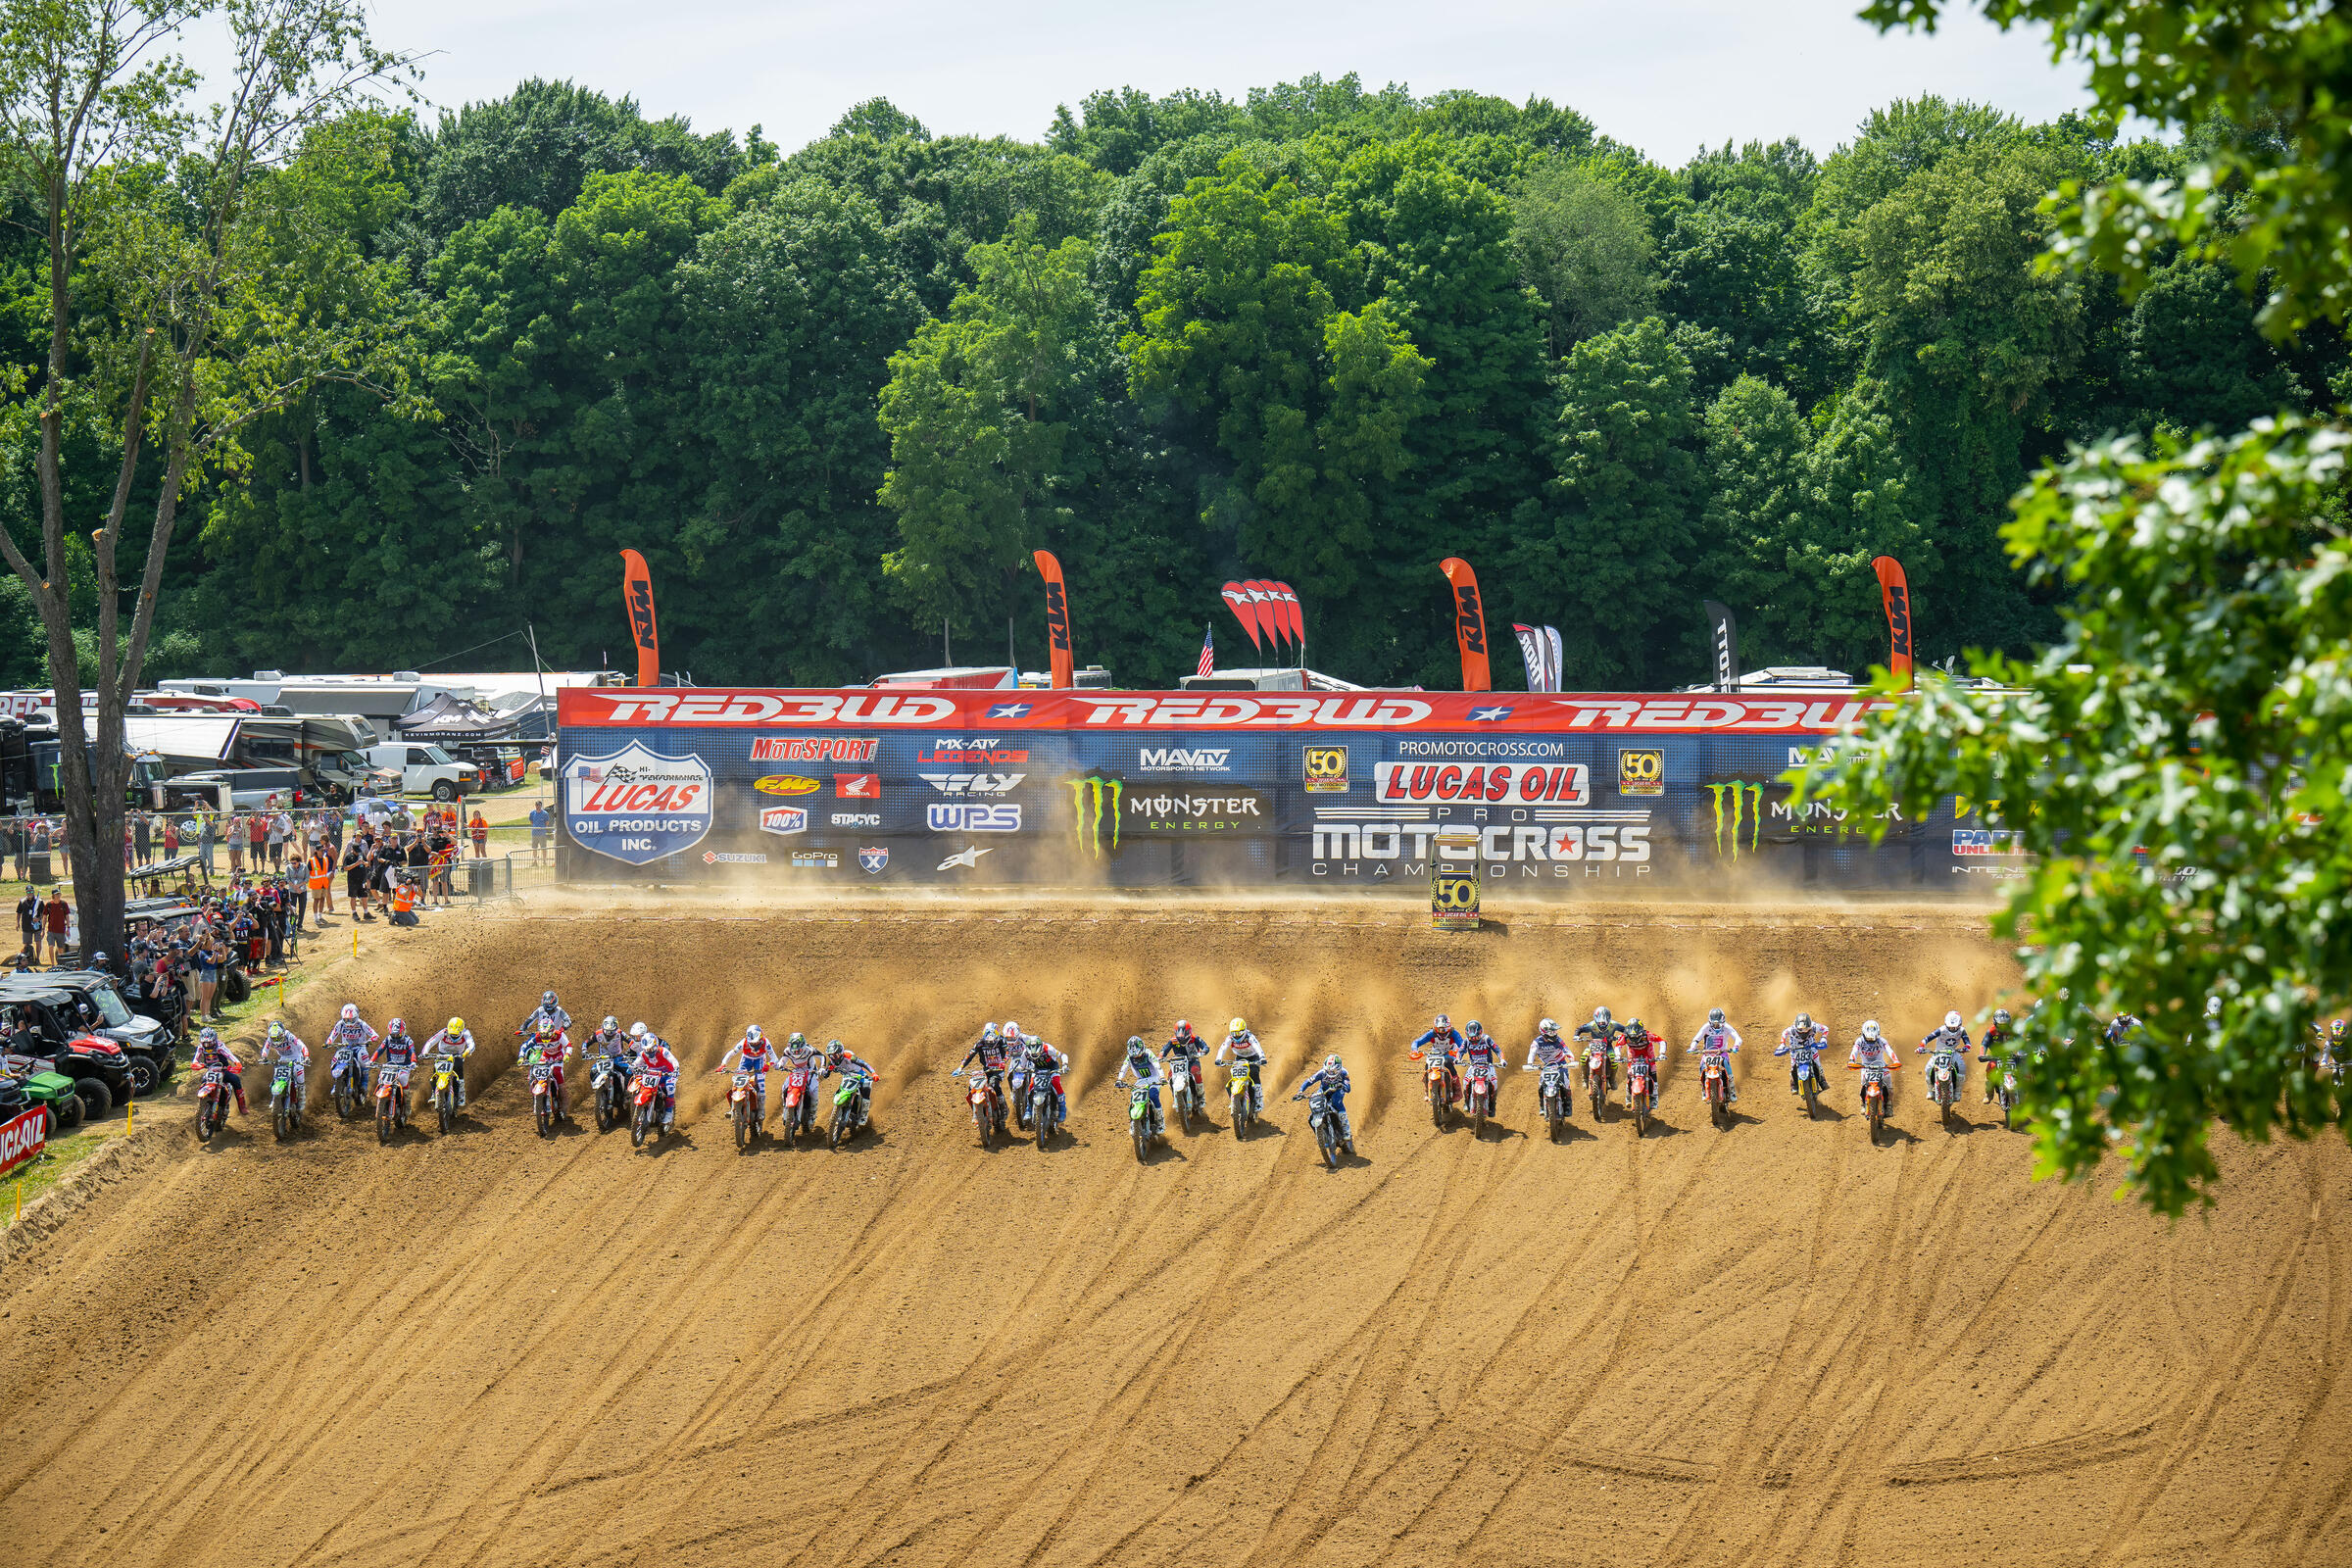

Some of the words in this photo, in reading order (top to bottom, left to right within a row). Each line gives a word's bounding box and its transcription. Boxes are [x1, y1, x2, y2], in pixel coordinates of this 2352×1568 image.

[629, 580, 656, 651] KTM
[1047, 581, 1069, 652] KTM
[1457, 585, 1485, 656] KTM
[589, 693, 956, 723] REDBUD
[1067, 697, 1433, 726] REDBUD
[935, 738, 963, 750] MX
[967, 738, 1001, 750] ATV
[1398, 741, 1564, 758] PROMOTOCROSS.COM
[916, 750, 1029, 766] LEGENDS
[1311, 751, 1343, 775] 50
[1626, 754, 1657, 778] 50
[1384, 764, 1512, 802] LUCAS
[1519, 765, 1581, 802] OIL
[581, 784, 702, 811] LUCAS
[1130, 794, 1260, 817] MONSTER
[765, 812, 801, 827] 100%
[928, 805, 1020, 831] WPS
[1437, 807, 1528, 821] PRO
[574, 820, 604, 834] OIL
[608, 819, 702, 832] PRODUCTS
[1150, 821, 1240, 830] ENERGY
[1790, 825, 1867, 834] ENERG
[1312, 823, 1651, 861] MOTOCROSS
[717, 853, 767, 863] SUZUKI
[792, 851, 838, 859] GoPro
[865, 856, 881, 869] X
[1312, 861, 1651, 878] CHAMPIONSHIP
[1437, 879, 1476, 908] 50
[337, 1051, 352, 1061] 35
[1428, 1057, 1444, 1066] 73
[437, 1062, 452, 1072] 41
[597, 1061, 612, 1071] 12
[1173, 1063, 1186, 1073] 63
[1632, 1065, 1647, 1076] 140
[207, 1072, 220, 1083] 51
[275, 1068, 289, 1077] 65
[534, 1068, 551, 1078] 93
[1232, 1068, 1248, 1077] 285
[1544, 1072, 1559, 1082] 97
[1866, 1072, 1884, 1082] 129
[643, 1076, 658, 1088] 94
[734, 1076, 747, 1088] 5
[791, 1077, 804, 1087] 23
[842, 1078, 858, 1089] 17
[1037, 1077, 1051, 1088] 28
[1133, 1091, 1148, 1102] 21
